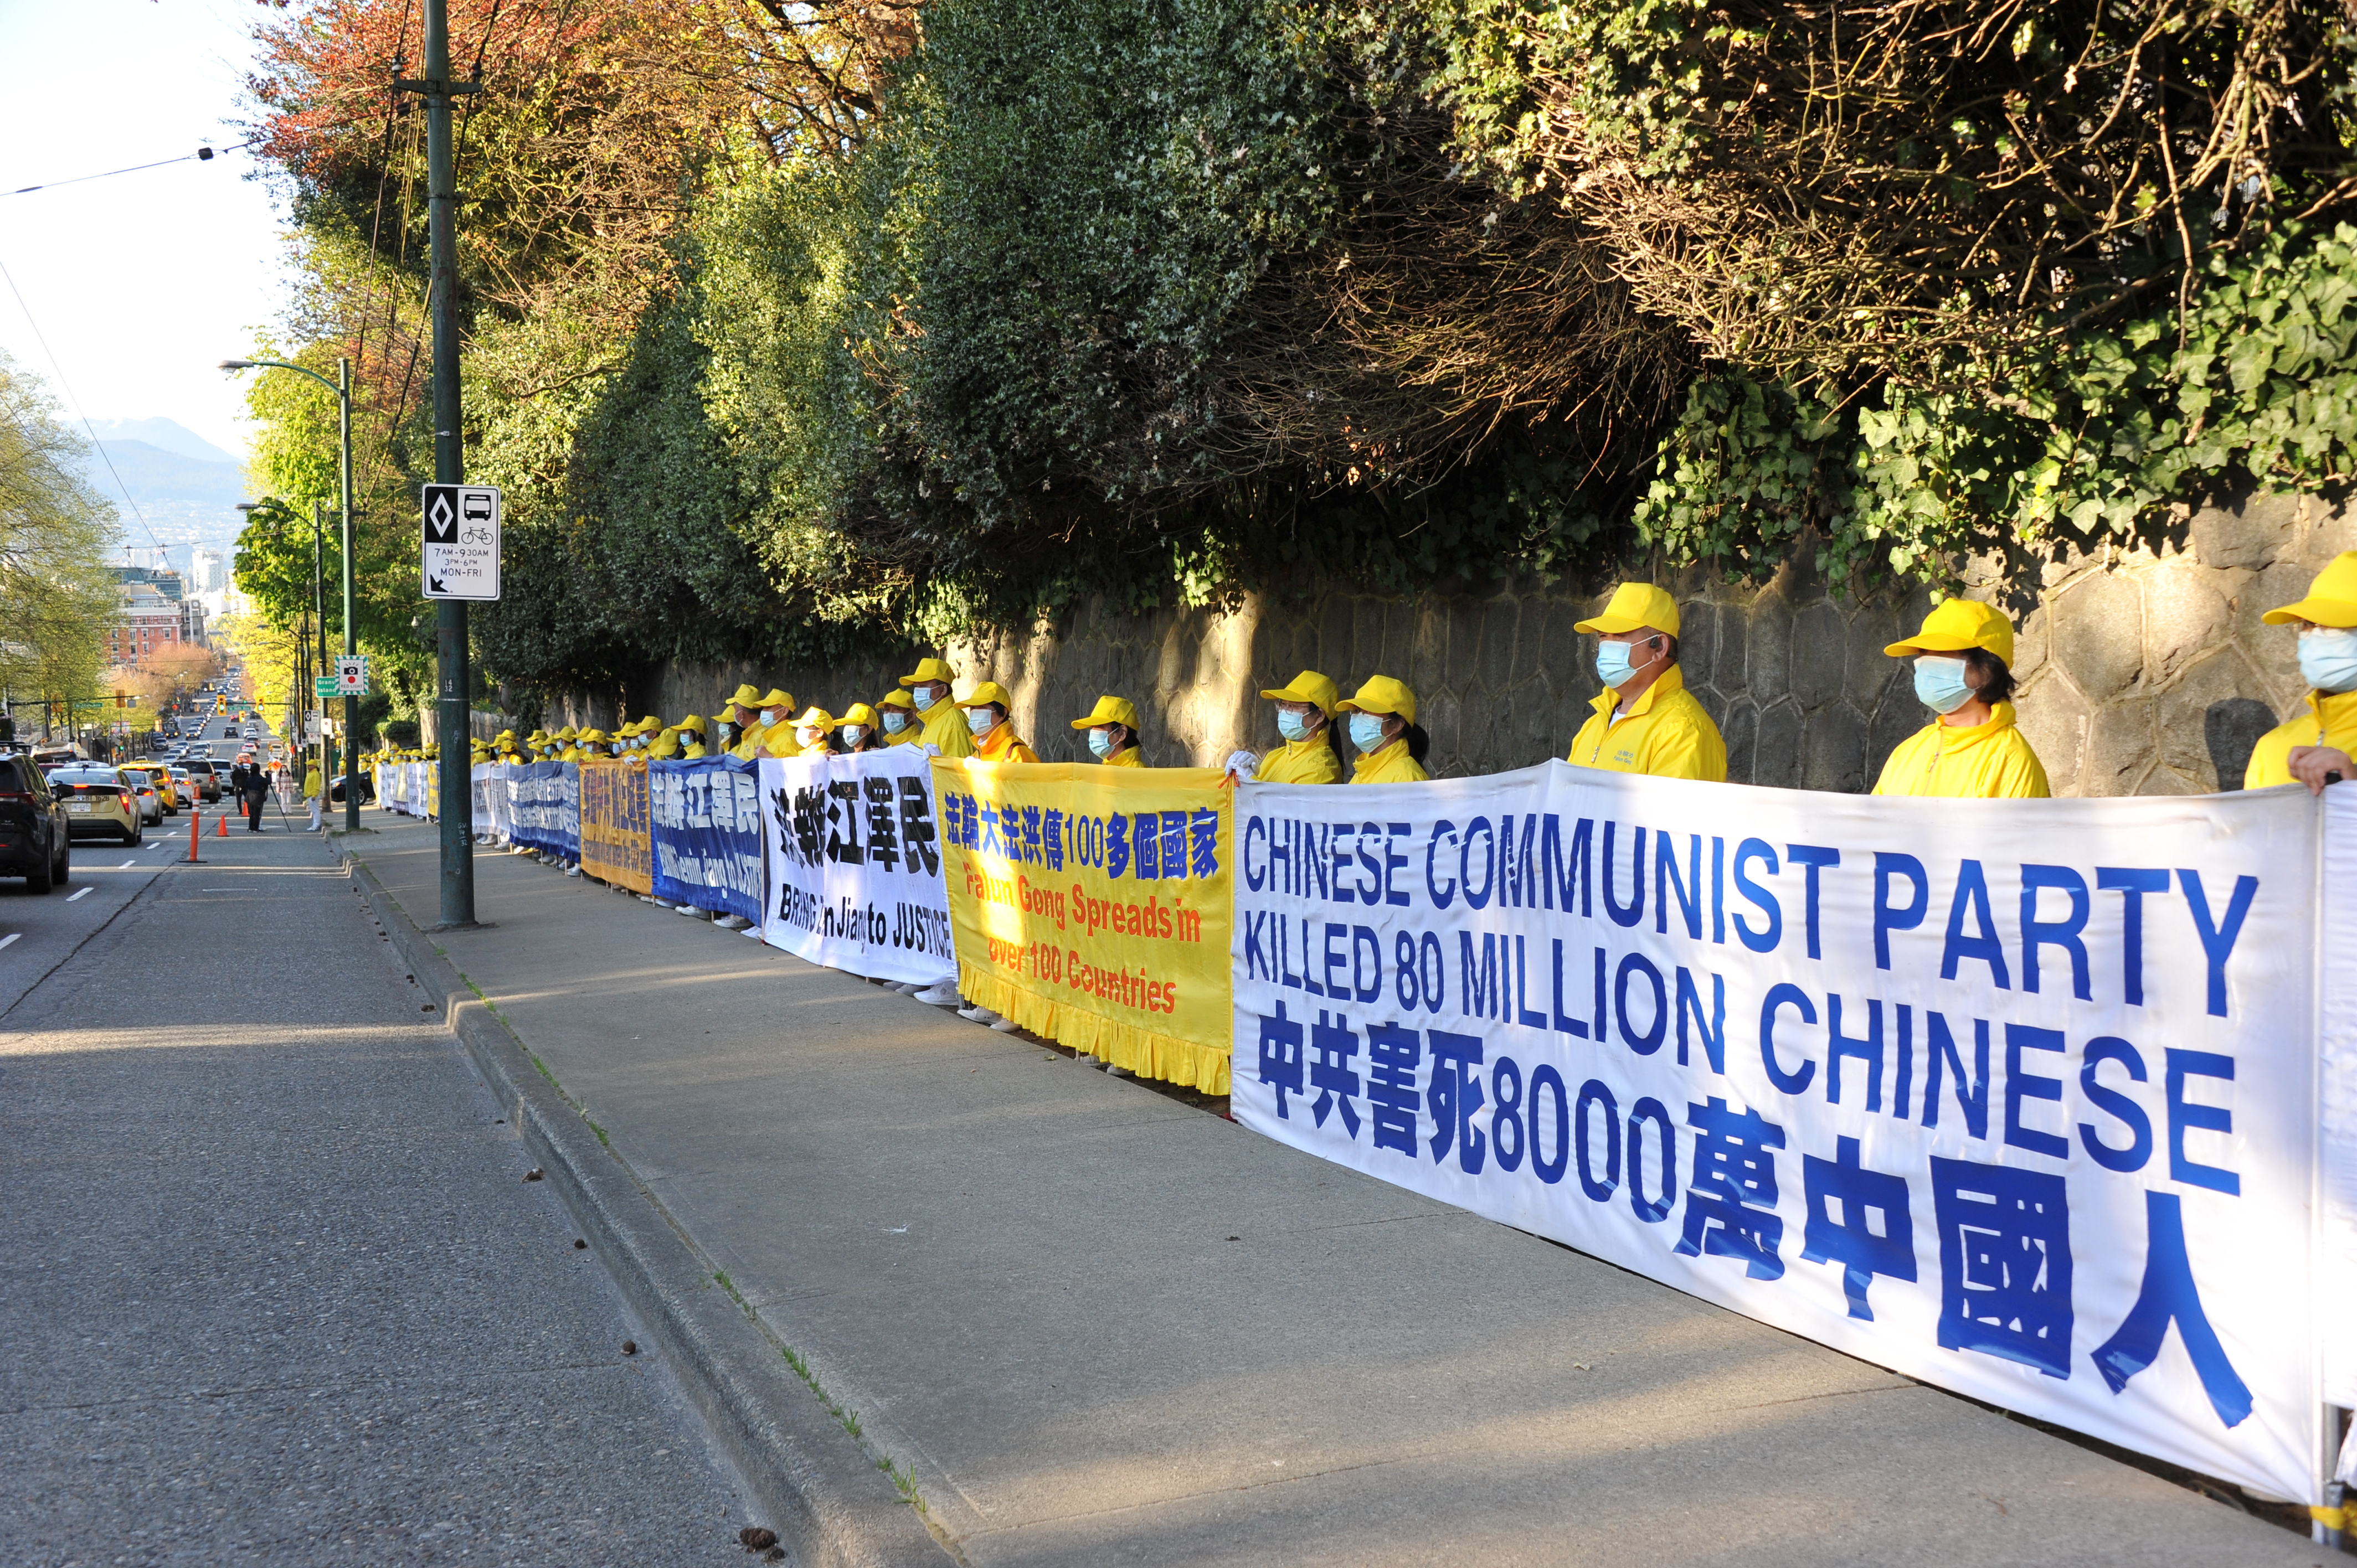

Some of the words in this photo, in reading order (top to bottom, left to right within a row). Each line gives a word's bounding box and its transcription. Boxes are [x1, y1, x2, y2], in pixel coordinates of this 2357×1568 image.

[440, 568, 481, 577] MON-FRI
[867, 901, 887, 946] to
[893, 901, 952, 961] JUSTICE
[963, 862, 1015, 906] Falun
[1018, 875, 1066, 931] Gong
[1072, 884, 1173, 940] Spreads
[1176, 898, 1201, 942] in
[1244, 815, 1411, 907] CHINESE
[1425, 813, 1840, 961] COMMUNIST
[1873, 852, 2260, 1018] PARTY
[988, 936, 1025, 972] over
[1030, 941, 1062, 984] 100
[1068, 950, 1177, 1014] Countries
[1244, 910, 1382, 1003] KILLED
[1395, 930, 1444, 1014] 80
[1459, 930, 1725, 1075] MILLION
[1759, 982, 2241, 1197] CHINESE
[1258, 999, 2255, 1430] 中共害死8000萬中國人
